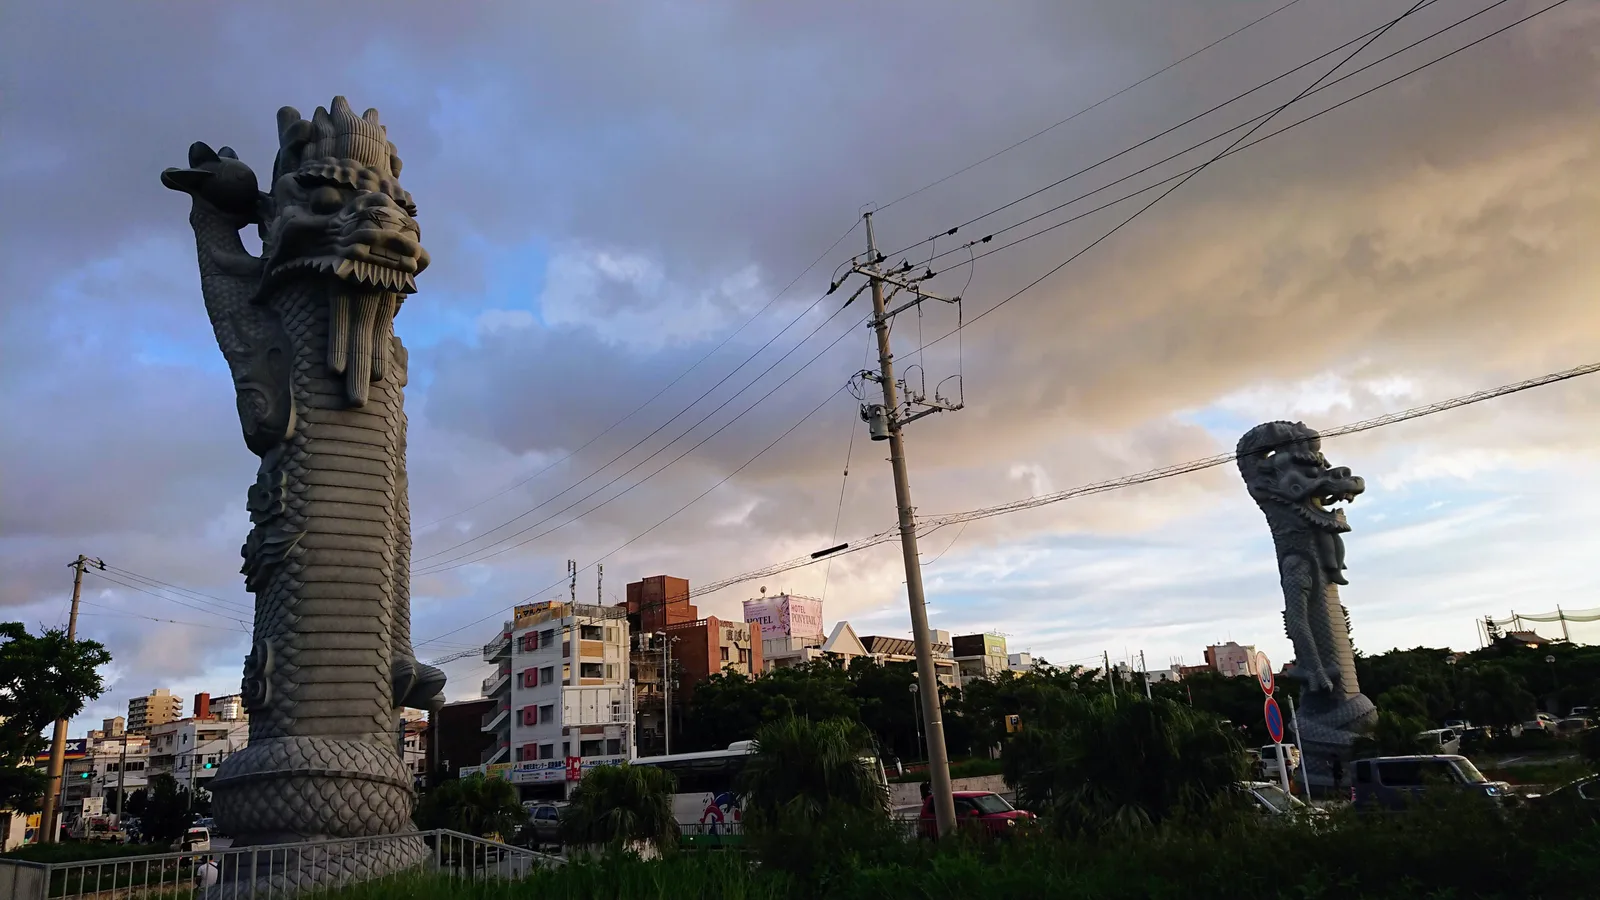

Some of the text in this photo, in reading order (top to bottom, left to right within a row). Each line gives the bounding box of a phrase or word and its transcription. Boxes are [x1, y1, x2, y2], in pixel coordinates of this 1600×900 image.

[791, 604, 806, 614] HOTEL
[746, 616, 774, 625] HOTEL
[791, 613, 817, 626] PONYTAIL
